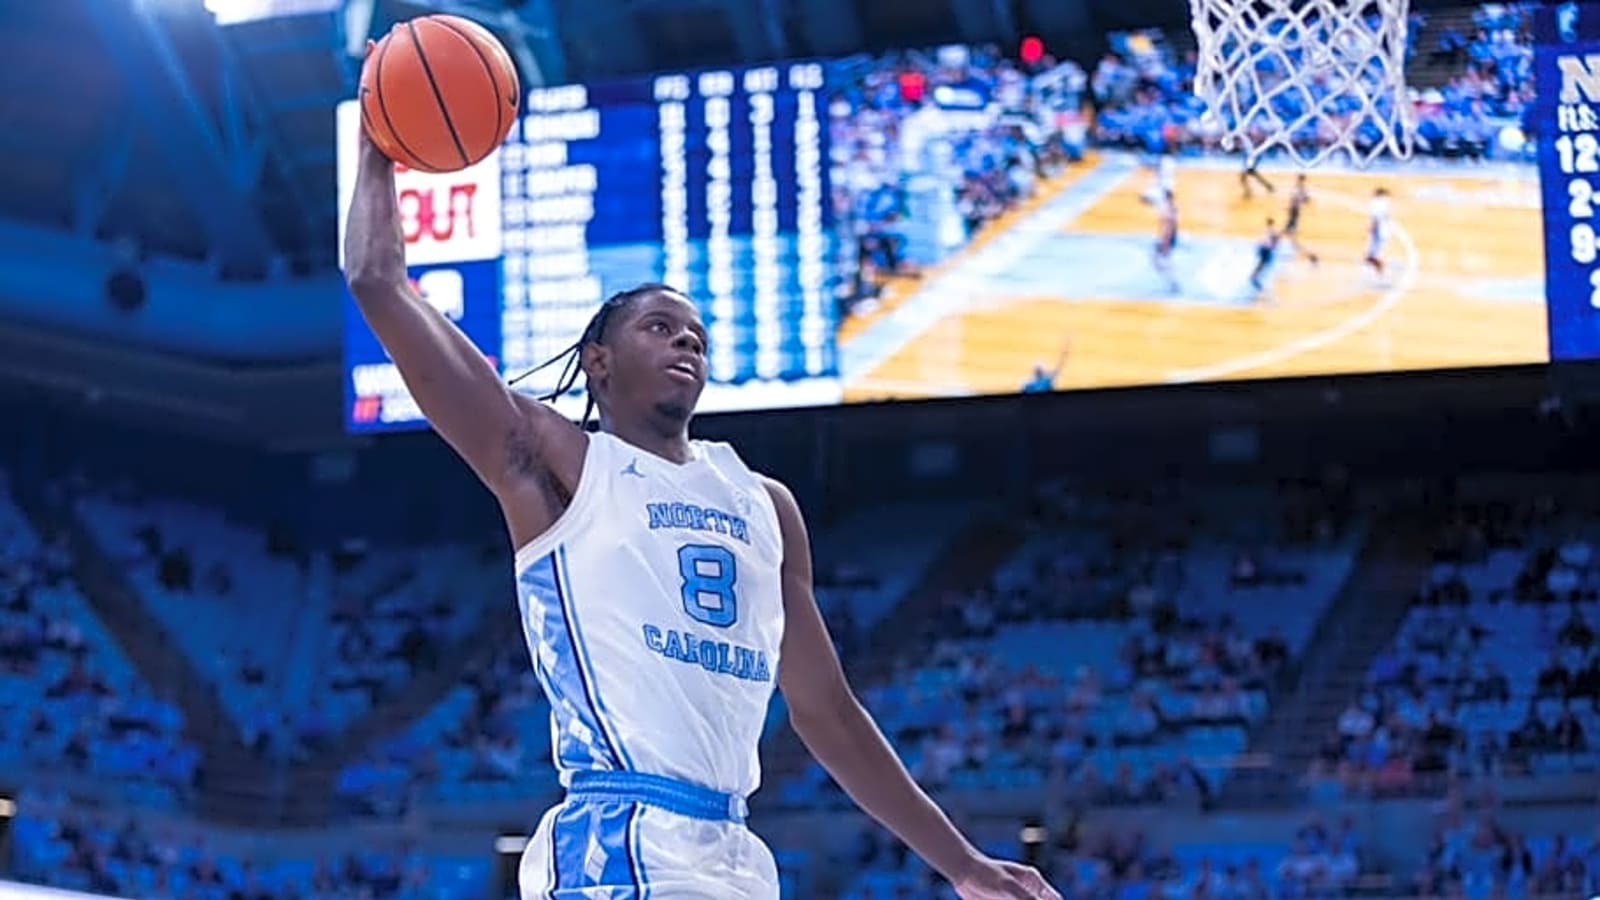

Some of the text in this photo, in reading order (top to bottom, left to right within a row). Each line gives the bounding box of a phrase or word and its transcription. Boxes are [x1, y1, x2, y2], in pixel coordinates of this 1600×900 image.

[646, 502, 750, 545] NORTH
[677, 543, 738, 629] 8
[642, 623, 770, 682] CAROLINA
